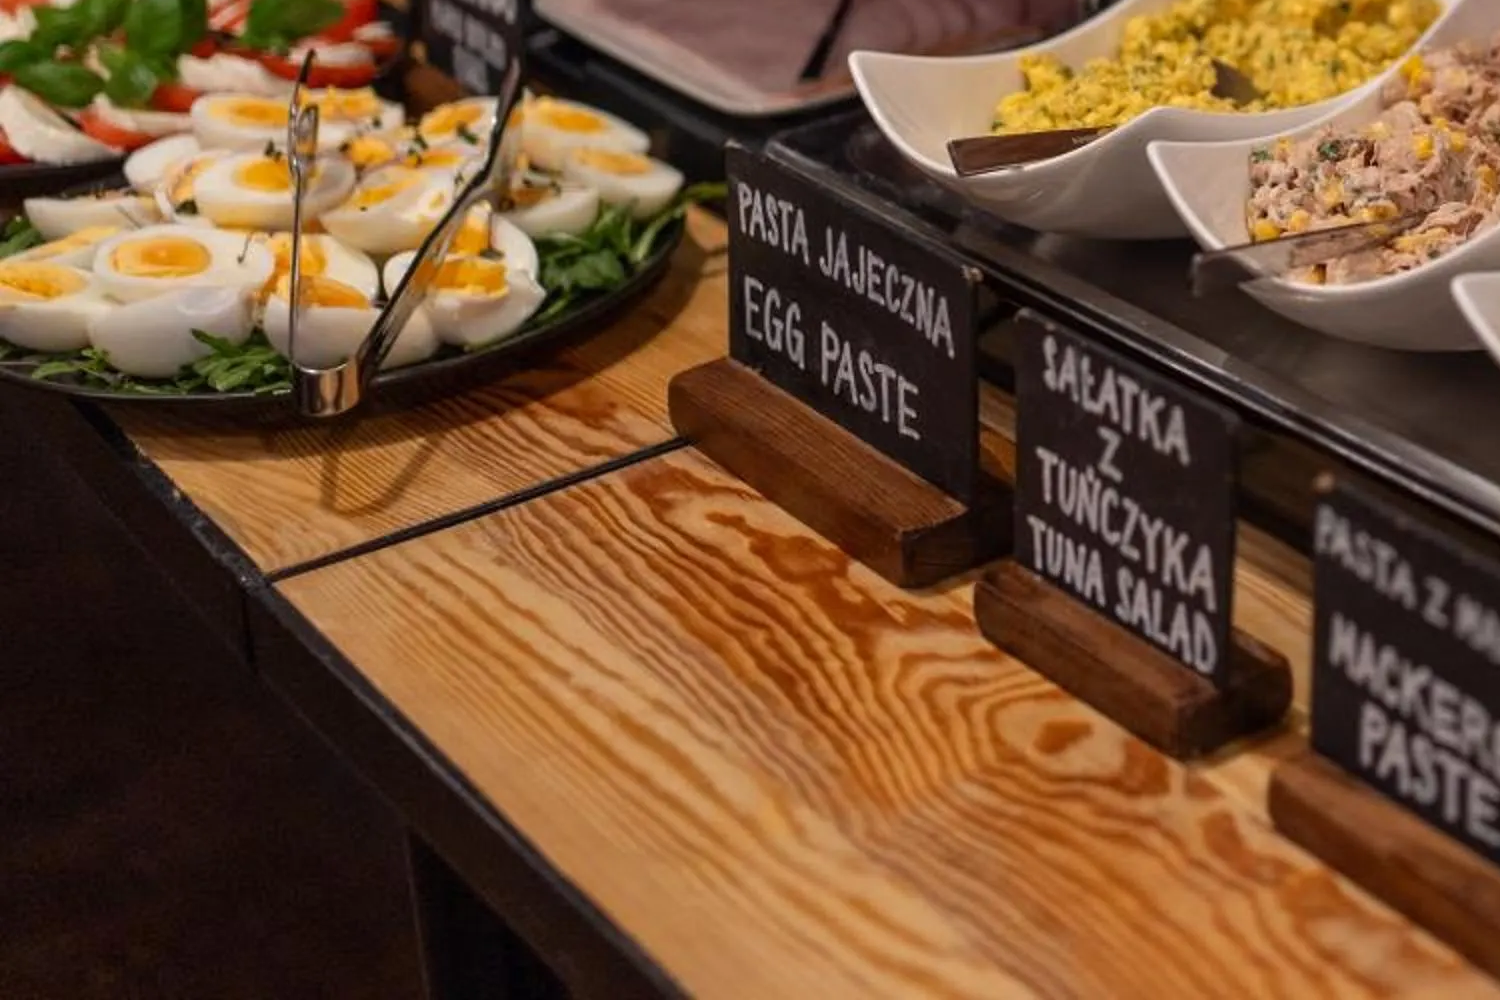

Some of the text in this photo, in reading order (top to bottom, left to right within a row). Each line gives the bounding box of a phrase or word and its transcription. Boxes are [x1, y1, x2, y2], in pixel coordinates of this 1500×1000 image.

[738, 182, 955, 359] PASTA JAJECZNA
[744, 276, 920, 441] EGG PASTE
[1043, 335, 1190, 466] SAŁATKA
[1036, 446, 1217, 612] TUŃCZYKA
[1097, 426, 1123, 482] Z
[1027, 515, 1218, 674] TUNA SALAD
[1313, 503, 1418, 611] PASTA
[1421, 576, 1451, 629] Z
